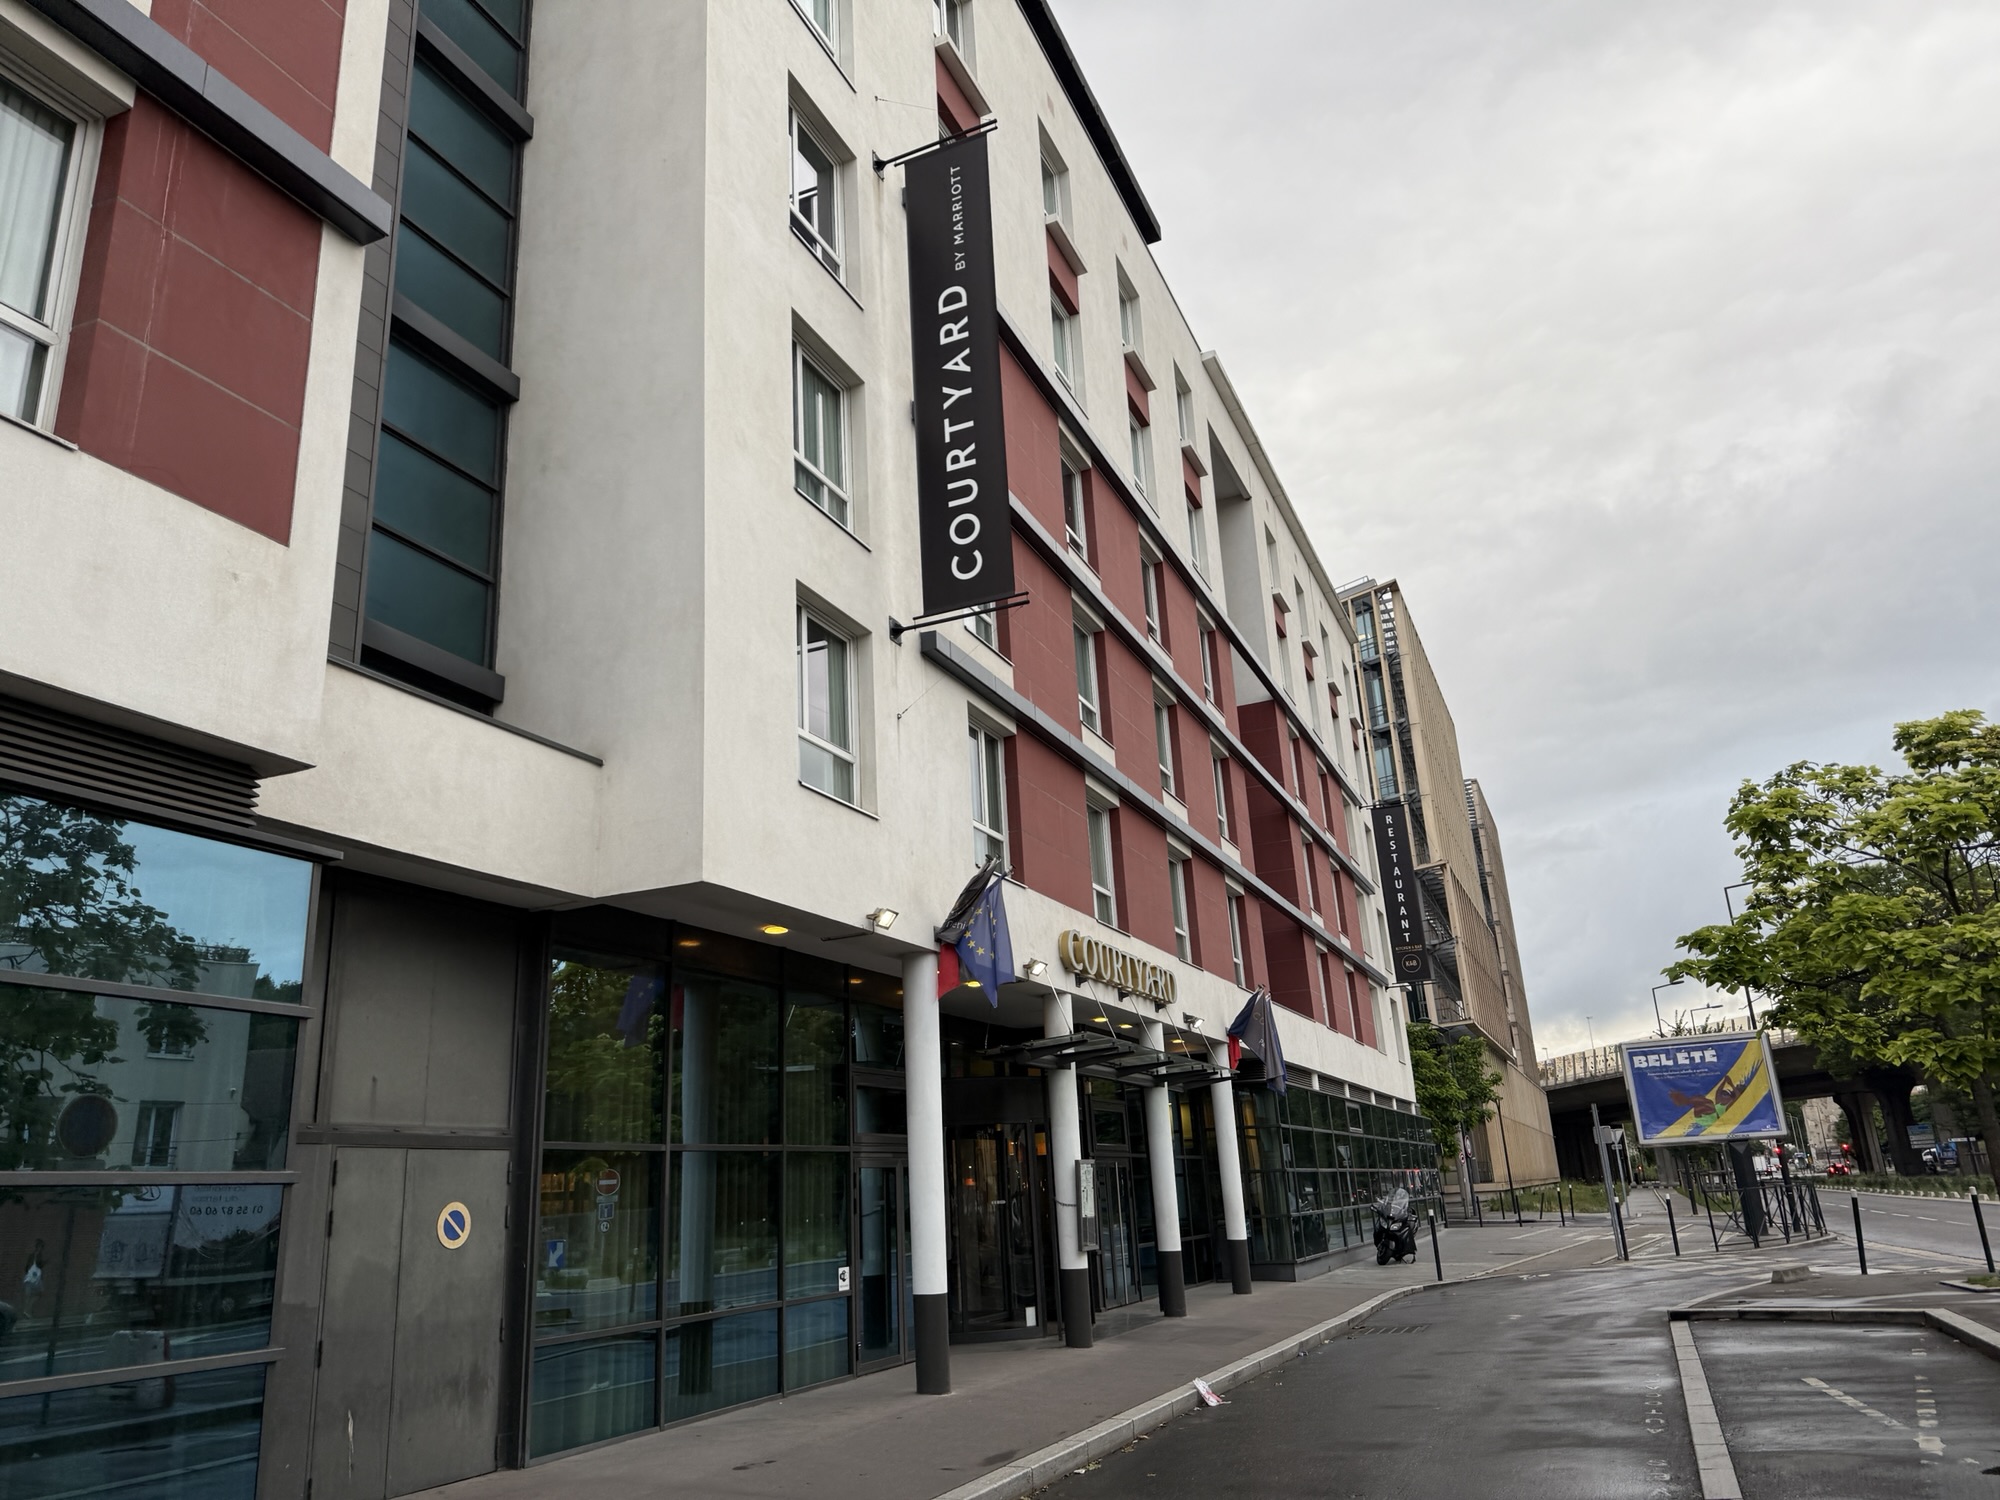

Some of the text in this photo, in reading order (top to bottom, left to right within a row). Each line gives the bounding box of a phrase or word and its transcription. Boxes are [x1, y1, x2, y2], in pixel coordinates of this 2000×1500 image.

[938, 165, 984, 581] COURTYARD BY MARRIOTT
[1385, 815, 1411, 943] RESTAURANT
[1064, 929, 1178, 1004] COURTYARD
[1632, 1048, 1718, 1068] BEL ÉTÉ
